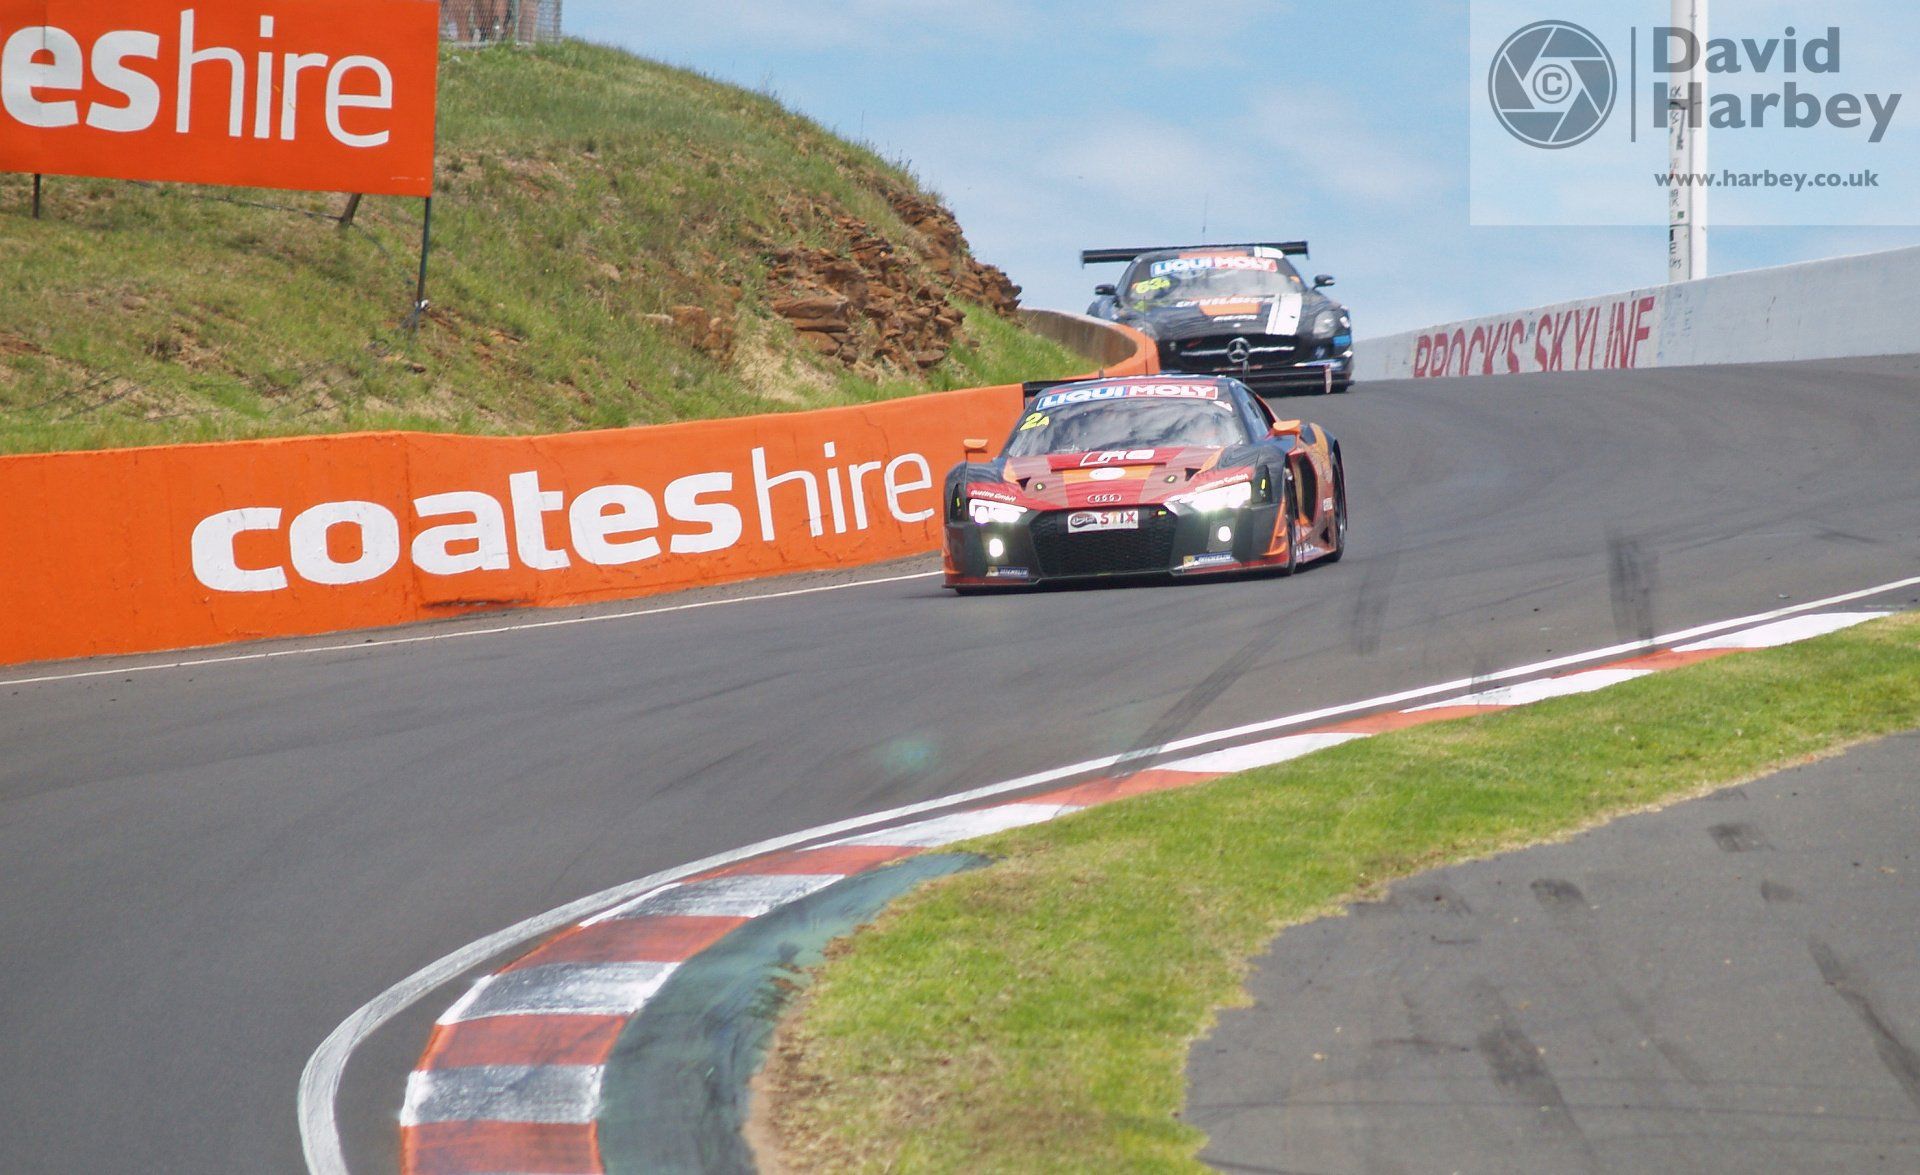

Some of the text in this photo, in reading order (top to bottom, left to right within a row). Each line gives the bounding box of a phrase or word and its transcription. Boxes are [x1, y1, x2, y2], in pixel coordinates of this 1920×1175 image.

[1413, 318, 1525, 379] BROCK'S
[1041, 384, 1214, 407] LIQUI MOLY
